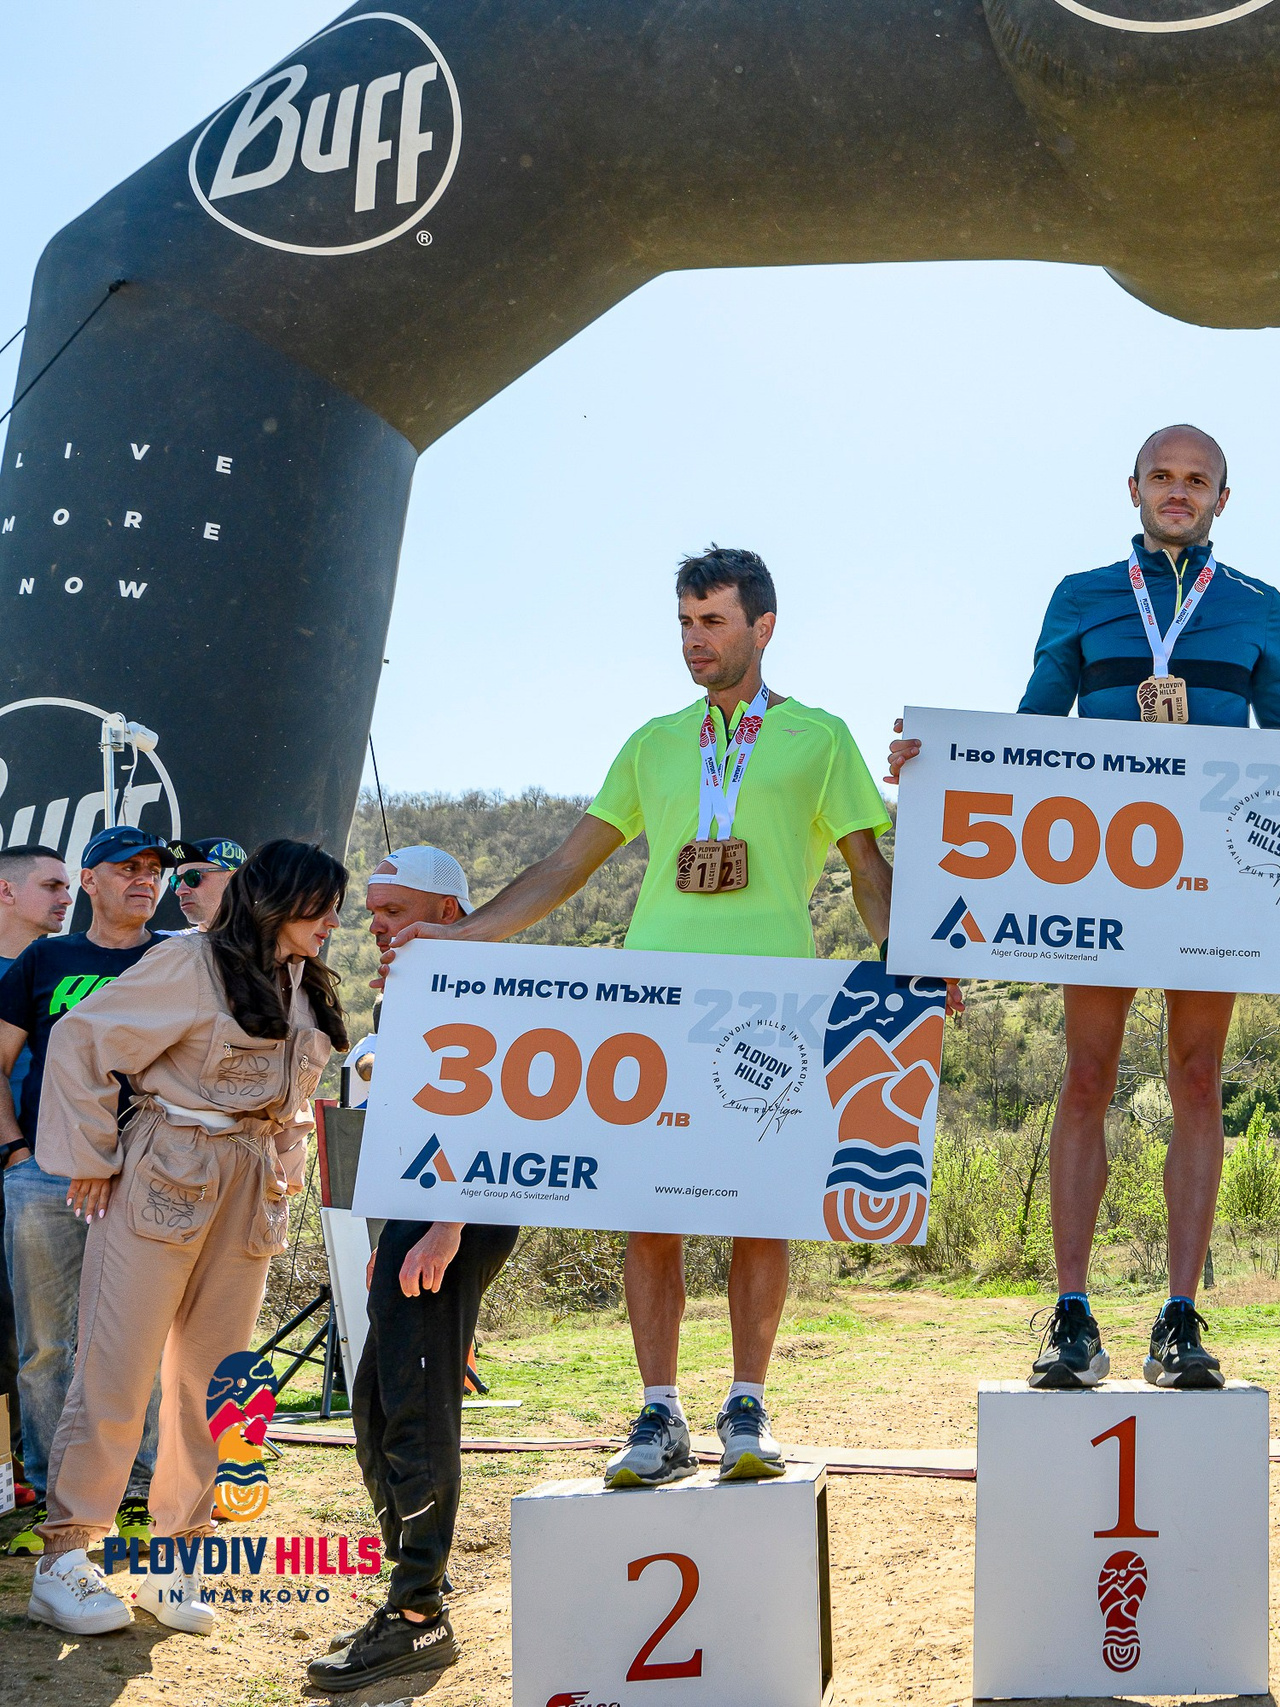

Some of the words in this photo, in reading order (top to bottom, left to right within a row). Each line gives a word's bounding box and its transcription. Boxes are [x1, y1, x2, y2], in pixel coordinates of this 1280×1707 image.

[2, 508, 221, 541] MORE
[18, 576, 148, 601] NOW
[1002, 746, 1096, 770] МЯСТО
[1102, 754, 1186, 776] МЪЖЕ
[1227, 791, 1260, 822] PLOVDIV
[938, 790, 1184, 890] 500
[1226, 838, 1242, 865] TRAIL
[992, 912, 1125, 951] AIGER
[991, 948, 1013, 958] Aiger
[1014, 950, 1038, 960] Group
[1039, 951, 1052, 960] AG
[1053, 952, 1098, 962] Switzerland
[1180, 946, 1261, 959] www.aiger.com
[492, 978, 588, 1000] МЯСТО
[596, 982, 682, 1006] МЪЖЕ
[716, 1021, 751, 1053] PLOVDIV
[757, 1019, 786, 1032] HILLS
[788, 1030, 799, 1041] IN
[794, 1044, 808, 1093] MARKOVO
[734, 1041, 792, 1079] PLOVDIV
[412, 1022, 668, 1126] 300
[712, 1071, 727, 1100] TRAIL
[734, 1062, 774, 1091] HILLS
[462, 1150, 598, 1190] AIGER
[460, 1188, 482, 1200] Aiger
[482, 1190, 508, 1202] Group
[510, 1190, 522, 1200] AG
[524, 1190, 570, 1202] Switzerland
[654, 1184, 739, 1198] www.aiger.com
[1090, 1414, 1160, 1538] 1
[626, 1552, 703, 1682] 2
[412, 1626, 448, 1652] HOKA
